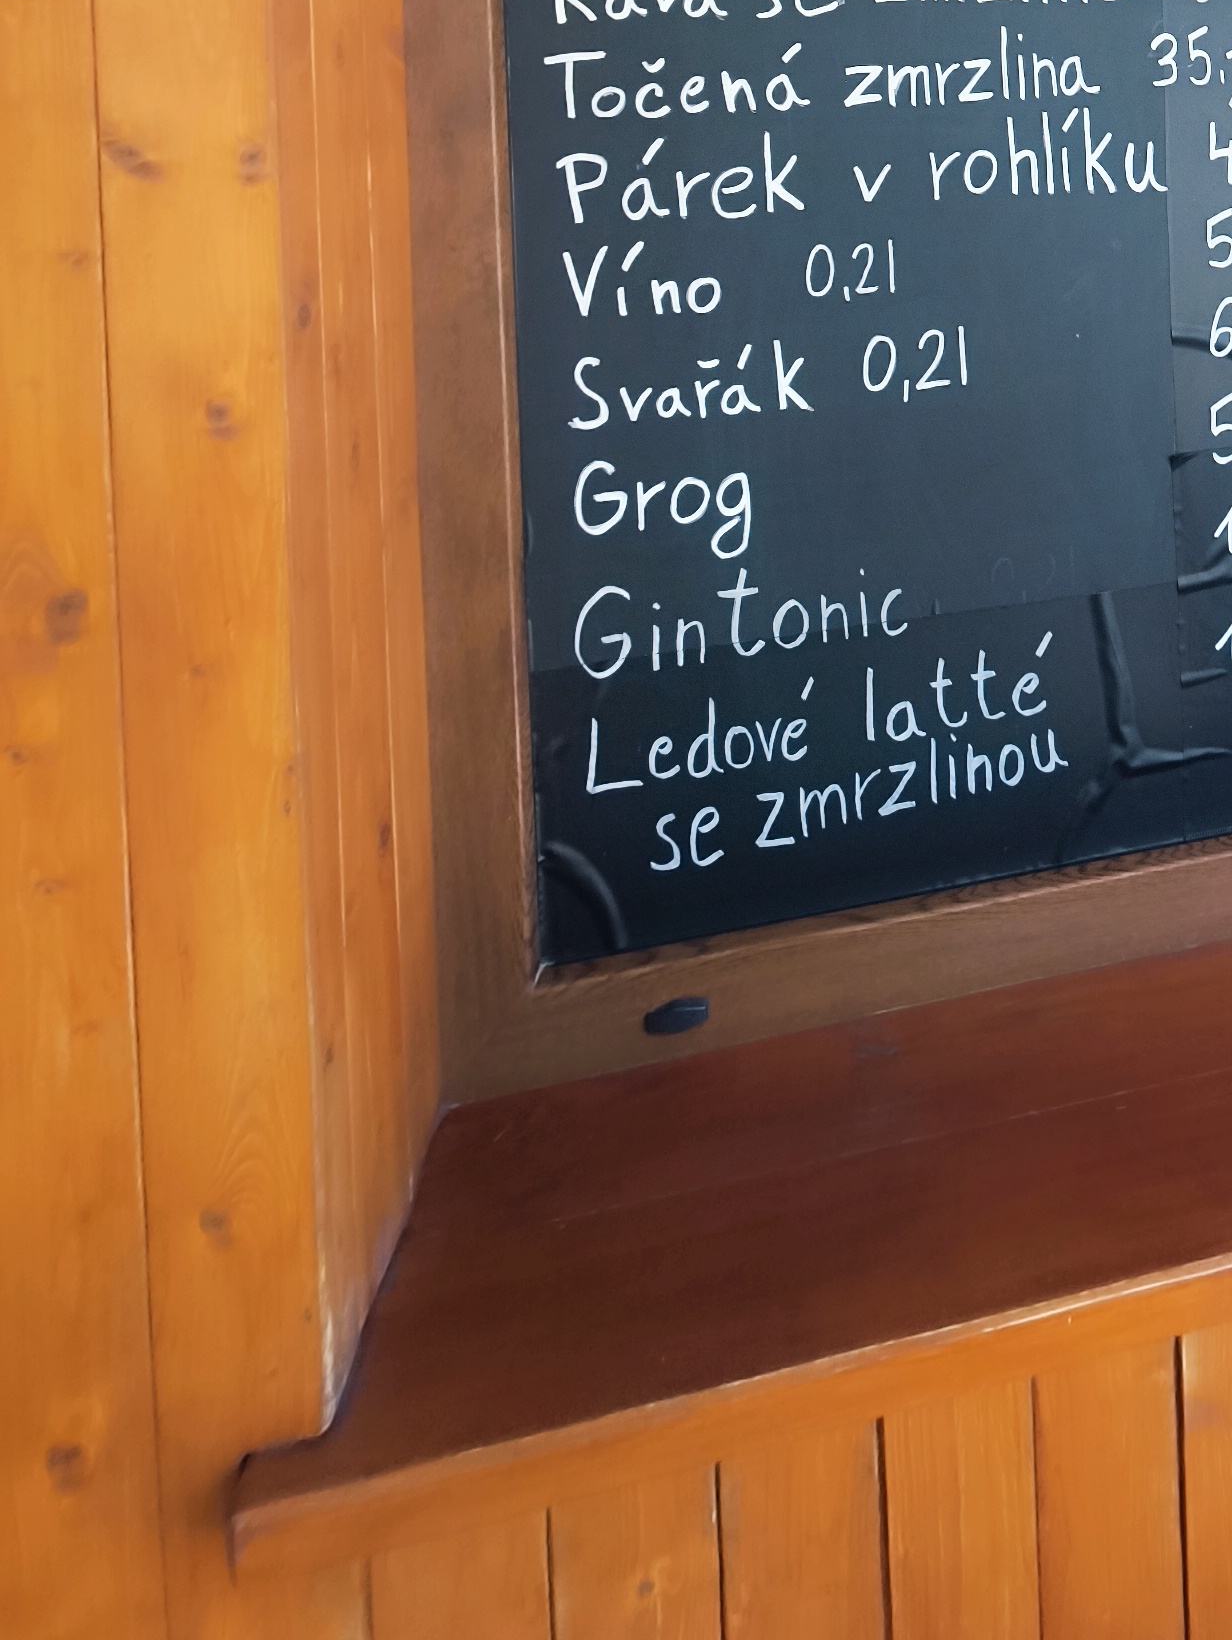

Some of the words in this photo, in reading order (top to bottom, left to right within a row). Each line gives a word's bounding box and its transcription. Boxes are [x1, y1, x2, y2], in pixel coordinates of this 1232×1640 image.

[543, 42, 812, 119] Točená
[843, 25, 1102, 109] zmrzlina
[555, 130, 806, 224] Párek
[852, 163, 893, 204] v
[929, 107, 1170, 202] rohlíku
[562, 240, 724, 318] Víno
[567, 338, 816, 431] Svařák
[573, 460, 753, 560] Grog
[585, 675, 816, 795] Ledové
[864, 629, 1054, 743] latté
[648, 805, 726, 872] se
[754, 727, 1070, 849] zmrzlinou
